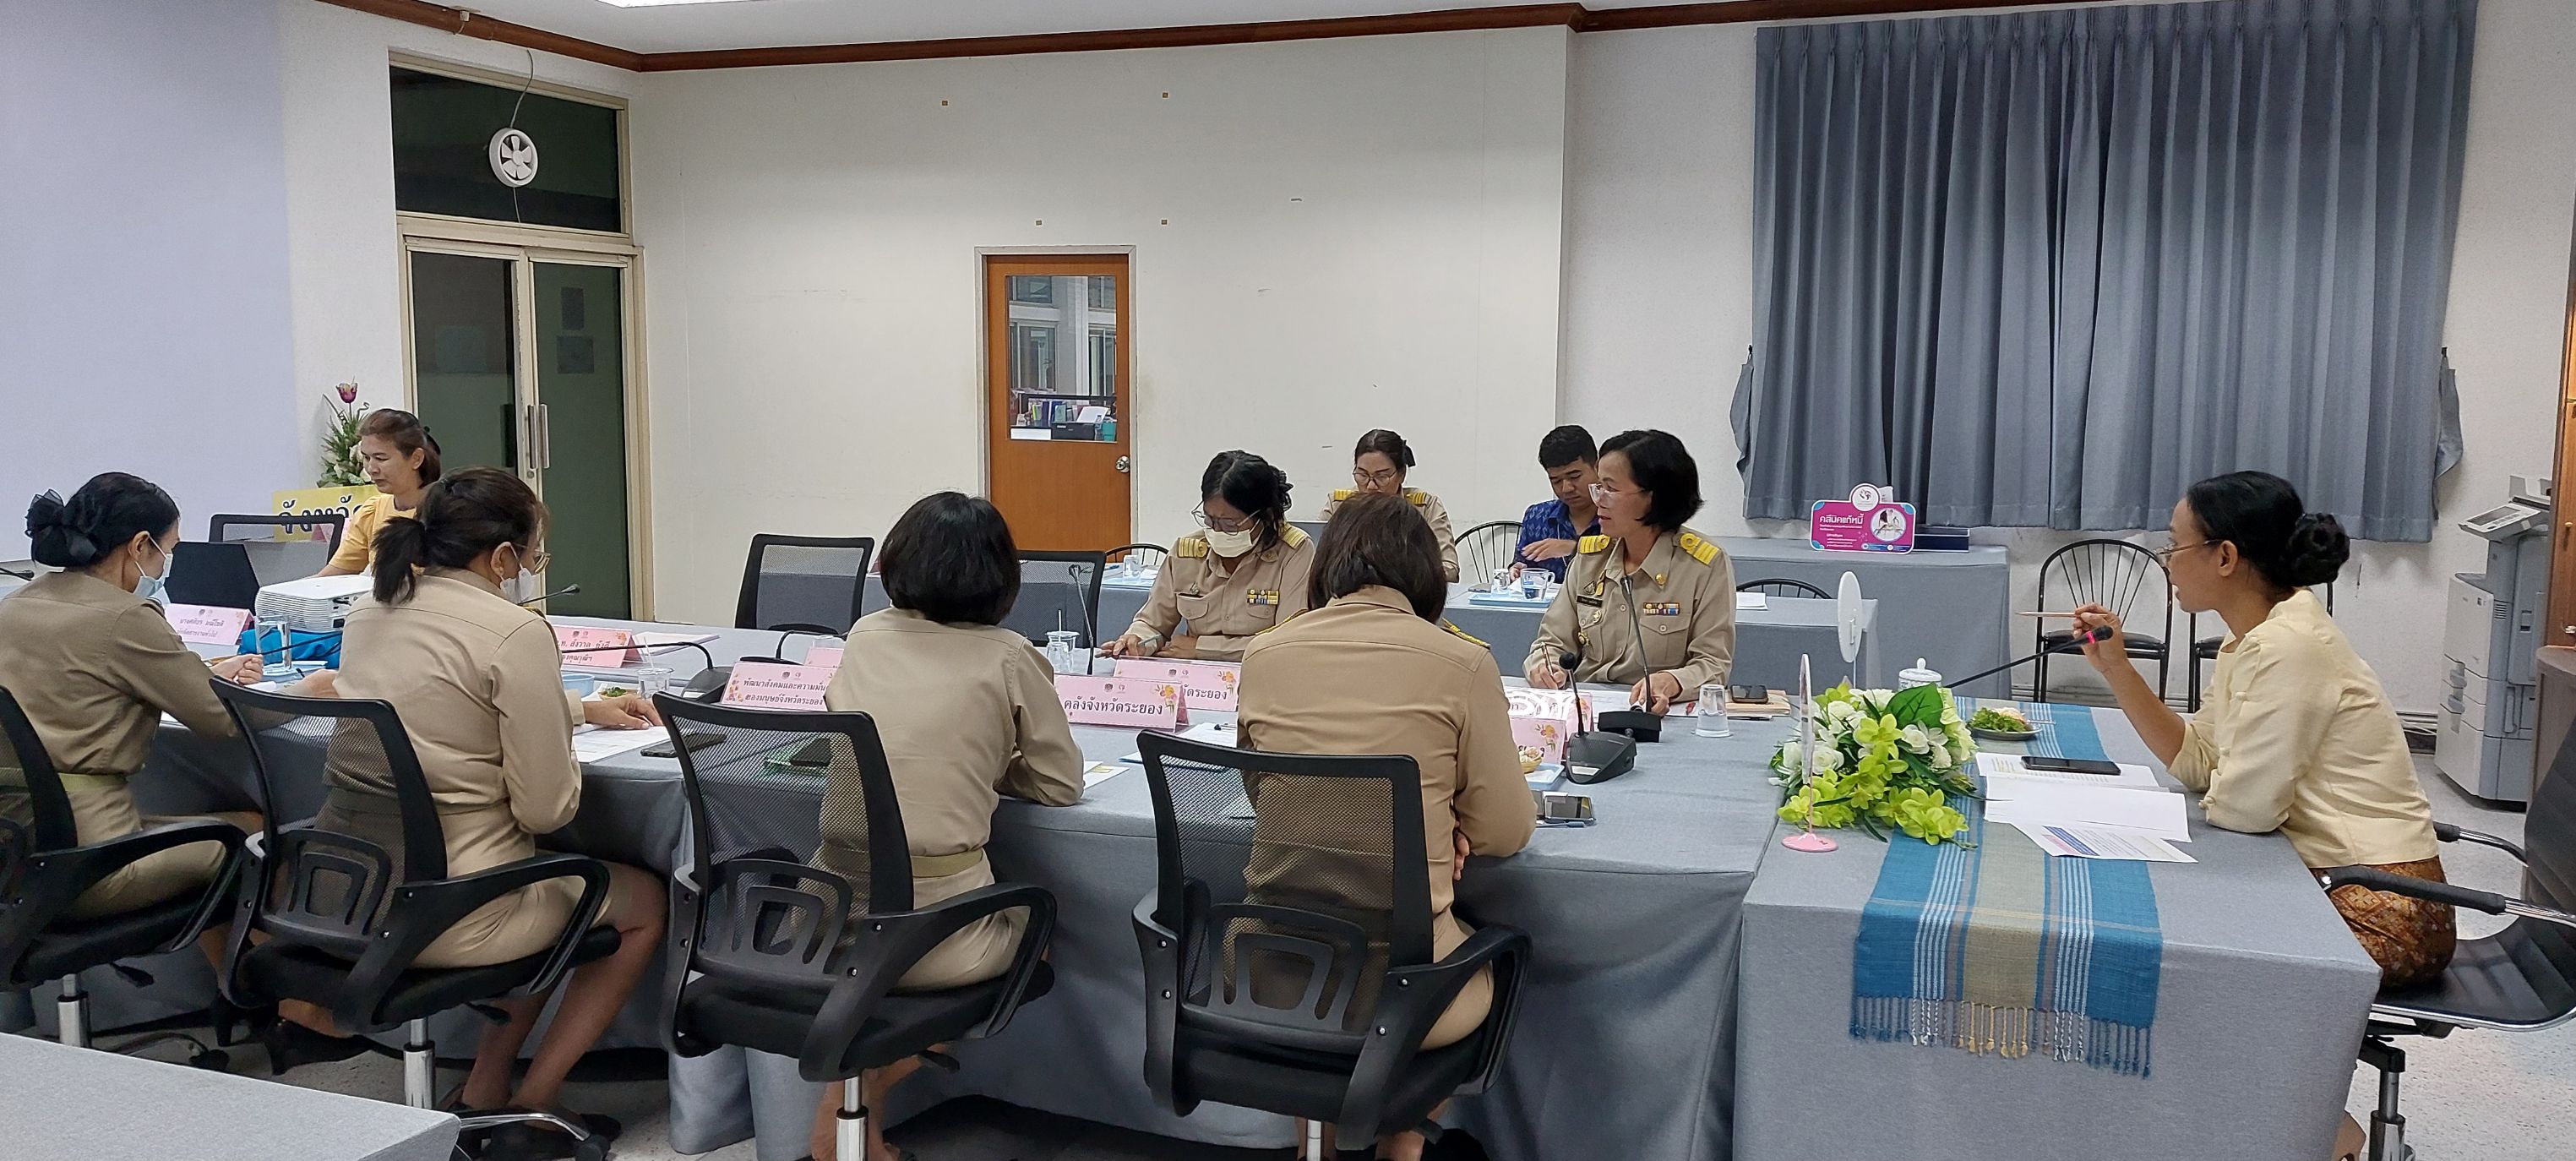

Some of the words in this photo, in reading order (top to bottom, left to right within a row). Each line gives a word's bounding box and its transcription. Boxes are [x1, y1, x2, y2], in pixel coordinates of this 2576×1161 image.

[1064, 695, 1163, 715] คลังจังหวัดระยอง
